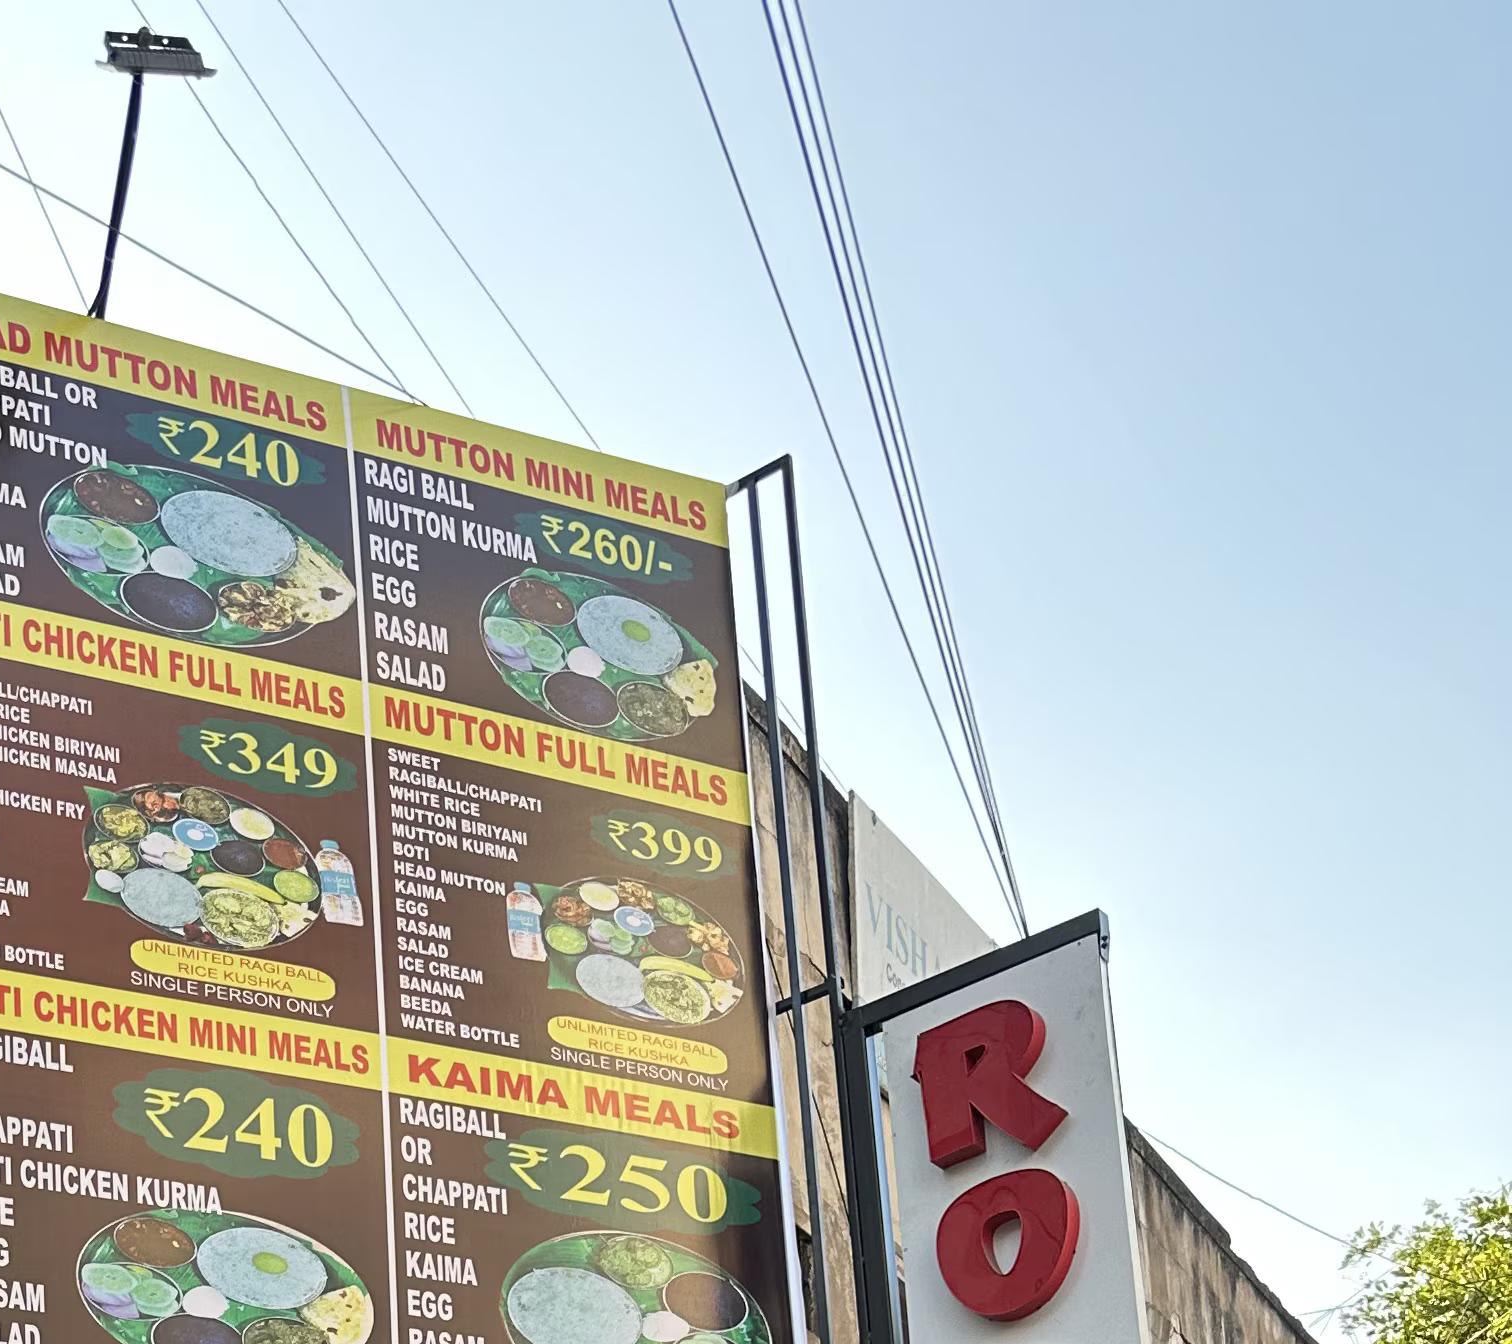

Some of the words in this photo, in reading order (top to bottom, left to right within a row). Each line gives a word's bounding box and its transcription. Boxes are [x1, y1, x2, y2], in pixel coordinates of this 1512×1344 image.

[0, 364, 58, 399] BALL
[64, 382, 98, 409] OR
[44, 331, 198, 399] MUTTON
[209, 375, 327, 432] MEALS
[9, 425, 108, 469] MUTTON
[364, 457, 415, 496] RAGI
[420, 472, 474, 511] BALL
[376, 418, 514, 481] MUTTON
[525, 457, 594, 502] MINI
[604, 479, 706, 530] MEALS
[366, 495, 456, 544] MUTTON
[462, 519, 538, 564] KURMA
[369, 533, 420, 572] RICE
[371, 572, 416, 608] EGG
[374, 611, 449, 655] RASAM
[22, 618, 159, 677] CHICKEN
[168, 650, 241, 696] FULL
[250, 669, 345, 719] MEALS
[376, 650, 446, 692] SALAD
[383, 696, 525, 758] MUTTON
[535, 731, 616, 778] FULL
[625, 752, 728, 805] MEALS
[56, 800, 85, 820] FRY
[142, 940, 234, 966] UNLIMITED
[239, 958, 280, 975] RAGI
[285, 966, 326, 983] BALL
[177, 962, 218, 979] RICE
[223, 970, 293, 993] KUSHKA
[130, 970, 199, 996] SINGLE
[204, 983, 281, 1009] PERSON
[286, 997, 333, 1018] ONLY
[33, 991, 178, 1042] CHICKEN
[189, 1017, 256, 1056] MINI
[268, 1030, 369, 1074] MEALS
[399, 1097, 506, 1140] RAGIBALL
[407, 1054, 568, 1108] KAIMA
[584, 1086, 739, 1139] MEALS
[400, 1135, 433, 1166] OR
[20, 1159, 129, 1202] CHICKEN
[136, 1175, 223, 1215] KURMA
[402, 1173, 508, 1215] CHAPPATI
[404, 1211, 456, 1245] RICE
[405, 1250, 478, 1286] KAIMA
[407, 1288, 453, 1321] EGG
